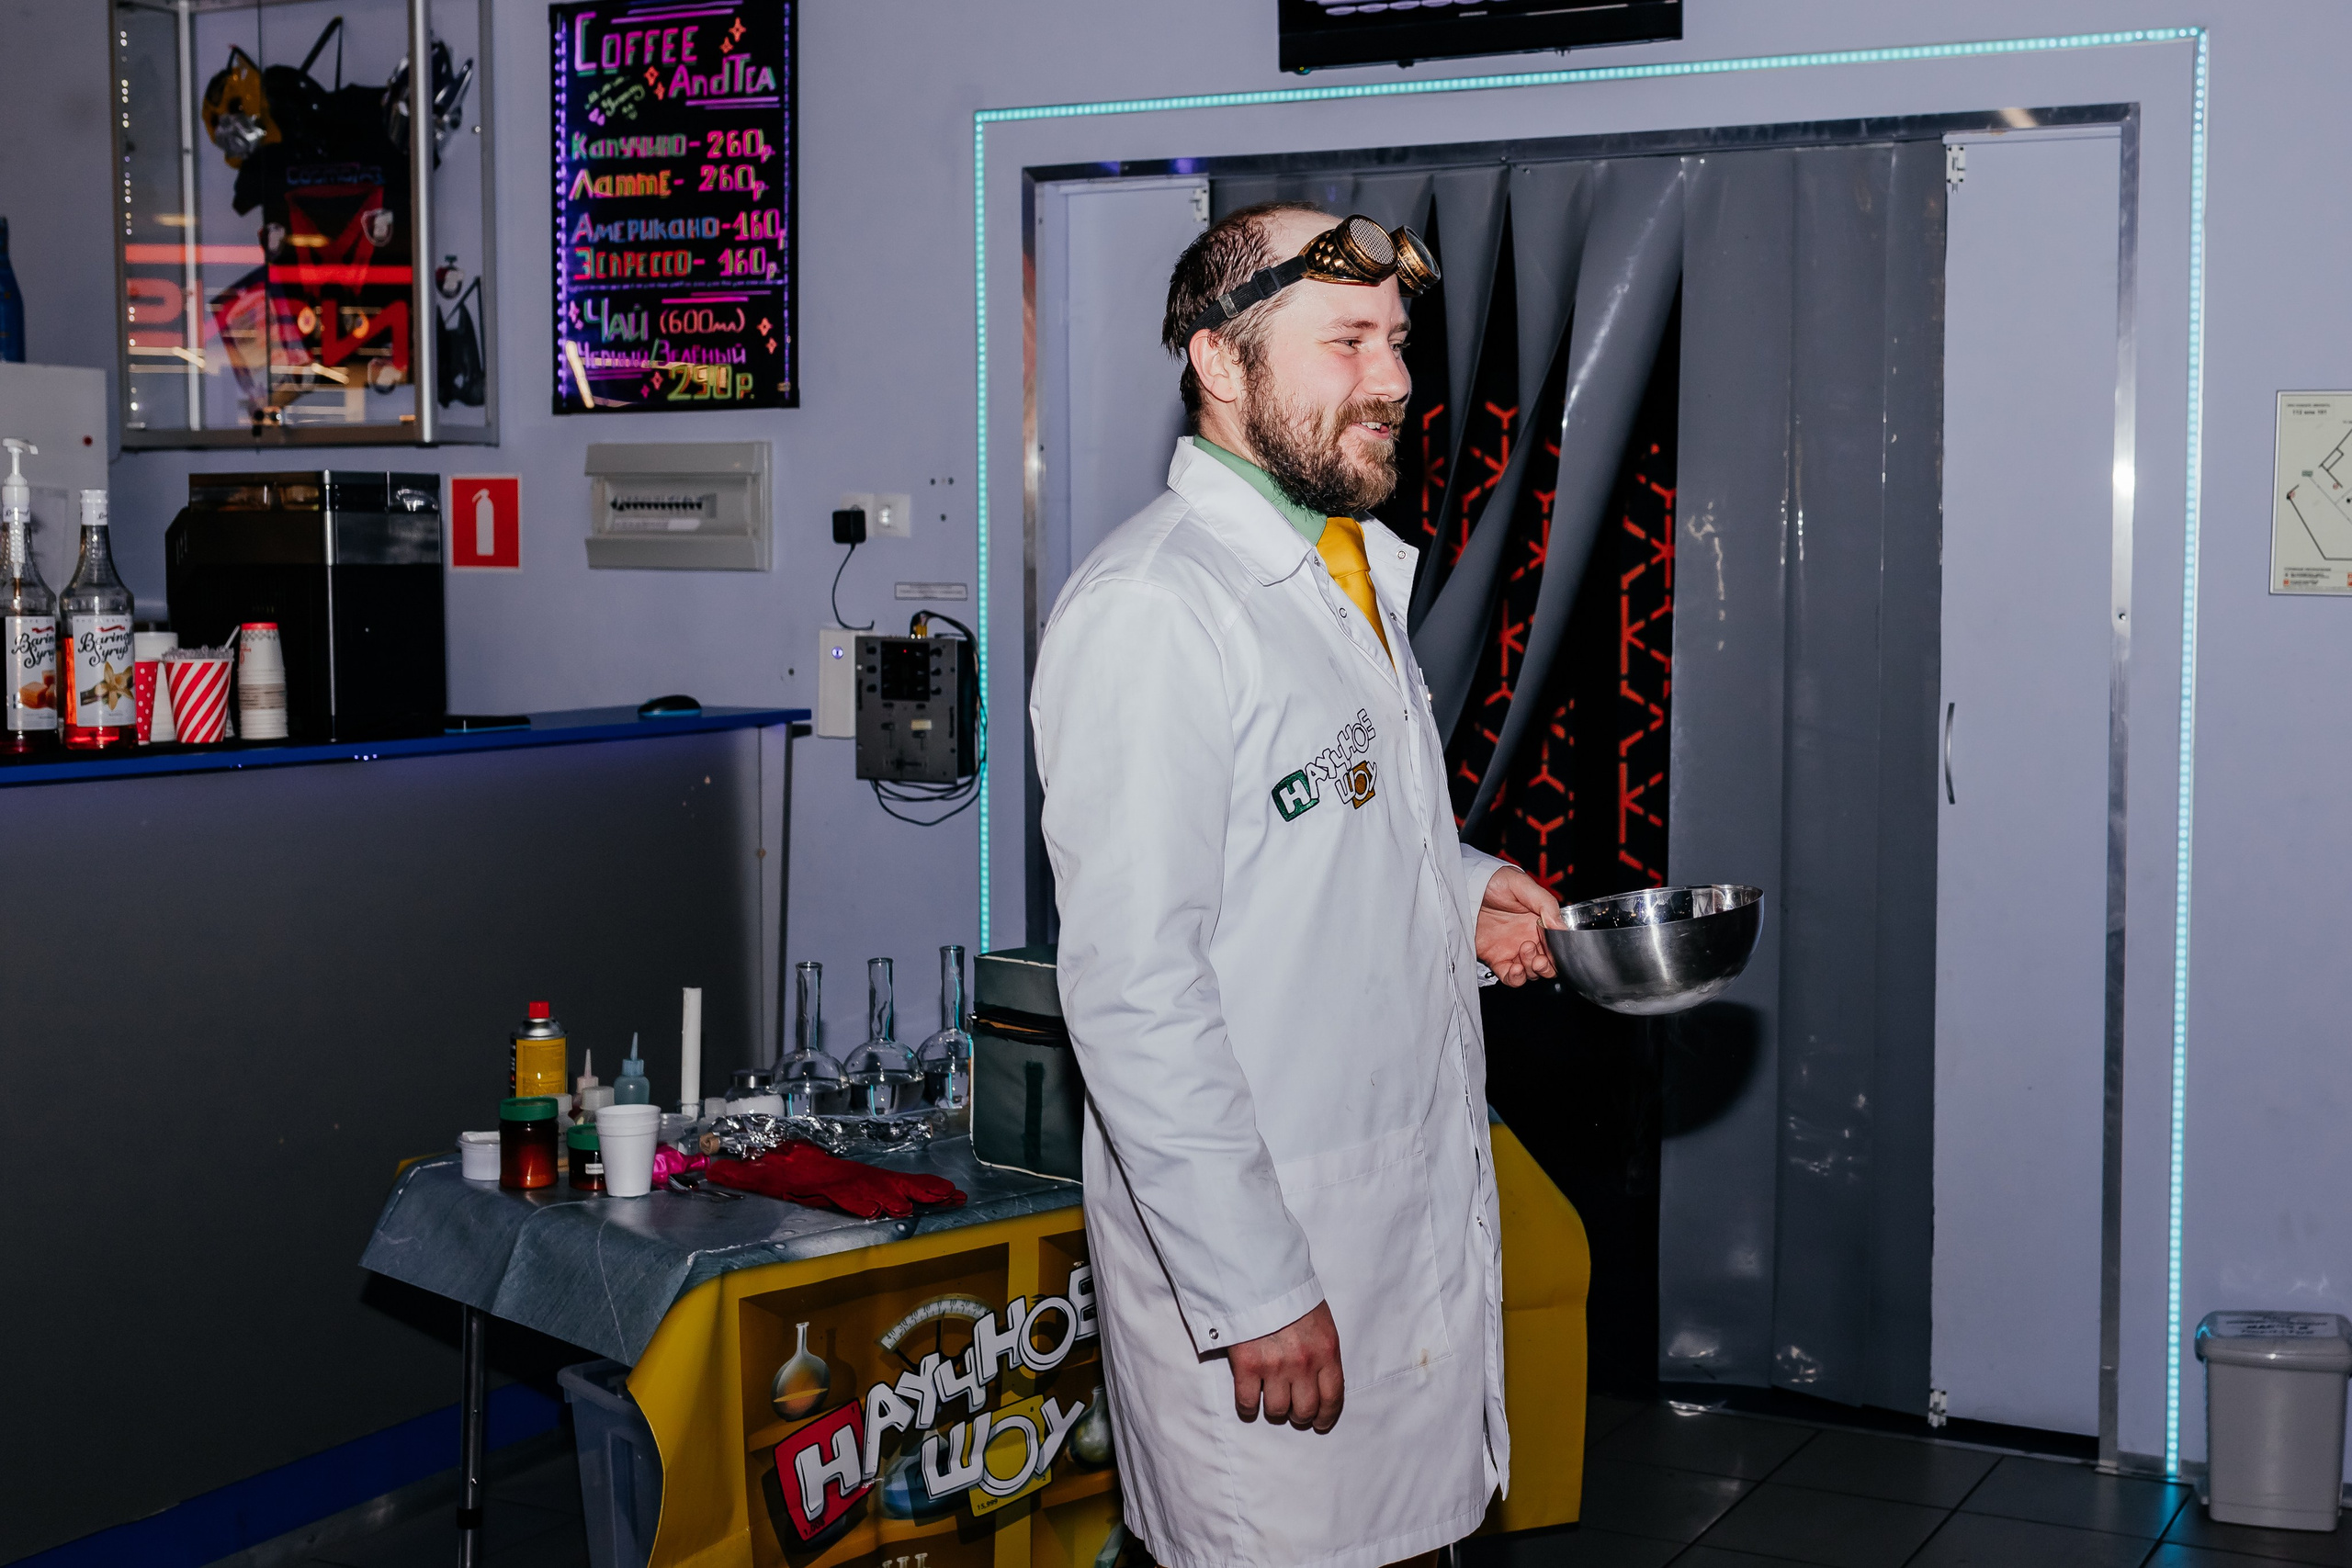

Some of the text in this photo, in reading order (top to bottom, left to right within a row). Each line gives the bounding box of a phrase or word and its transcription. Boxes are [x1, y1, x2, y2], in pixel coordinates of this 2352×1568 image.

[1278, 707, 1376, 816] НАУЧНОЕ
[1334, 760, 1378, 805] ШОУ
[921, 1395, 1086, 1501] ШОУ
